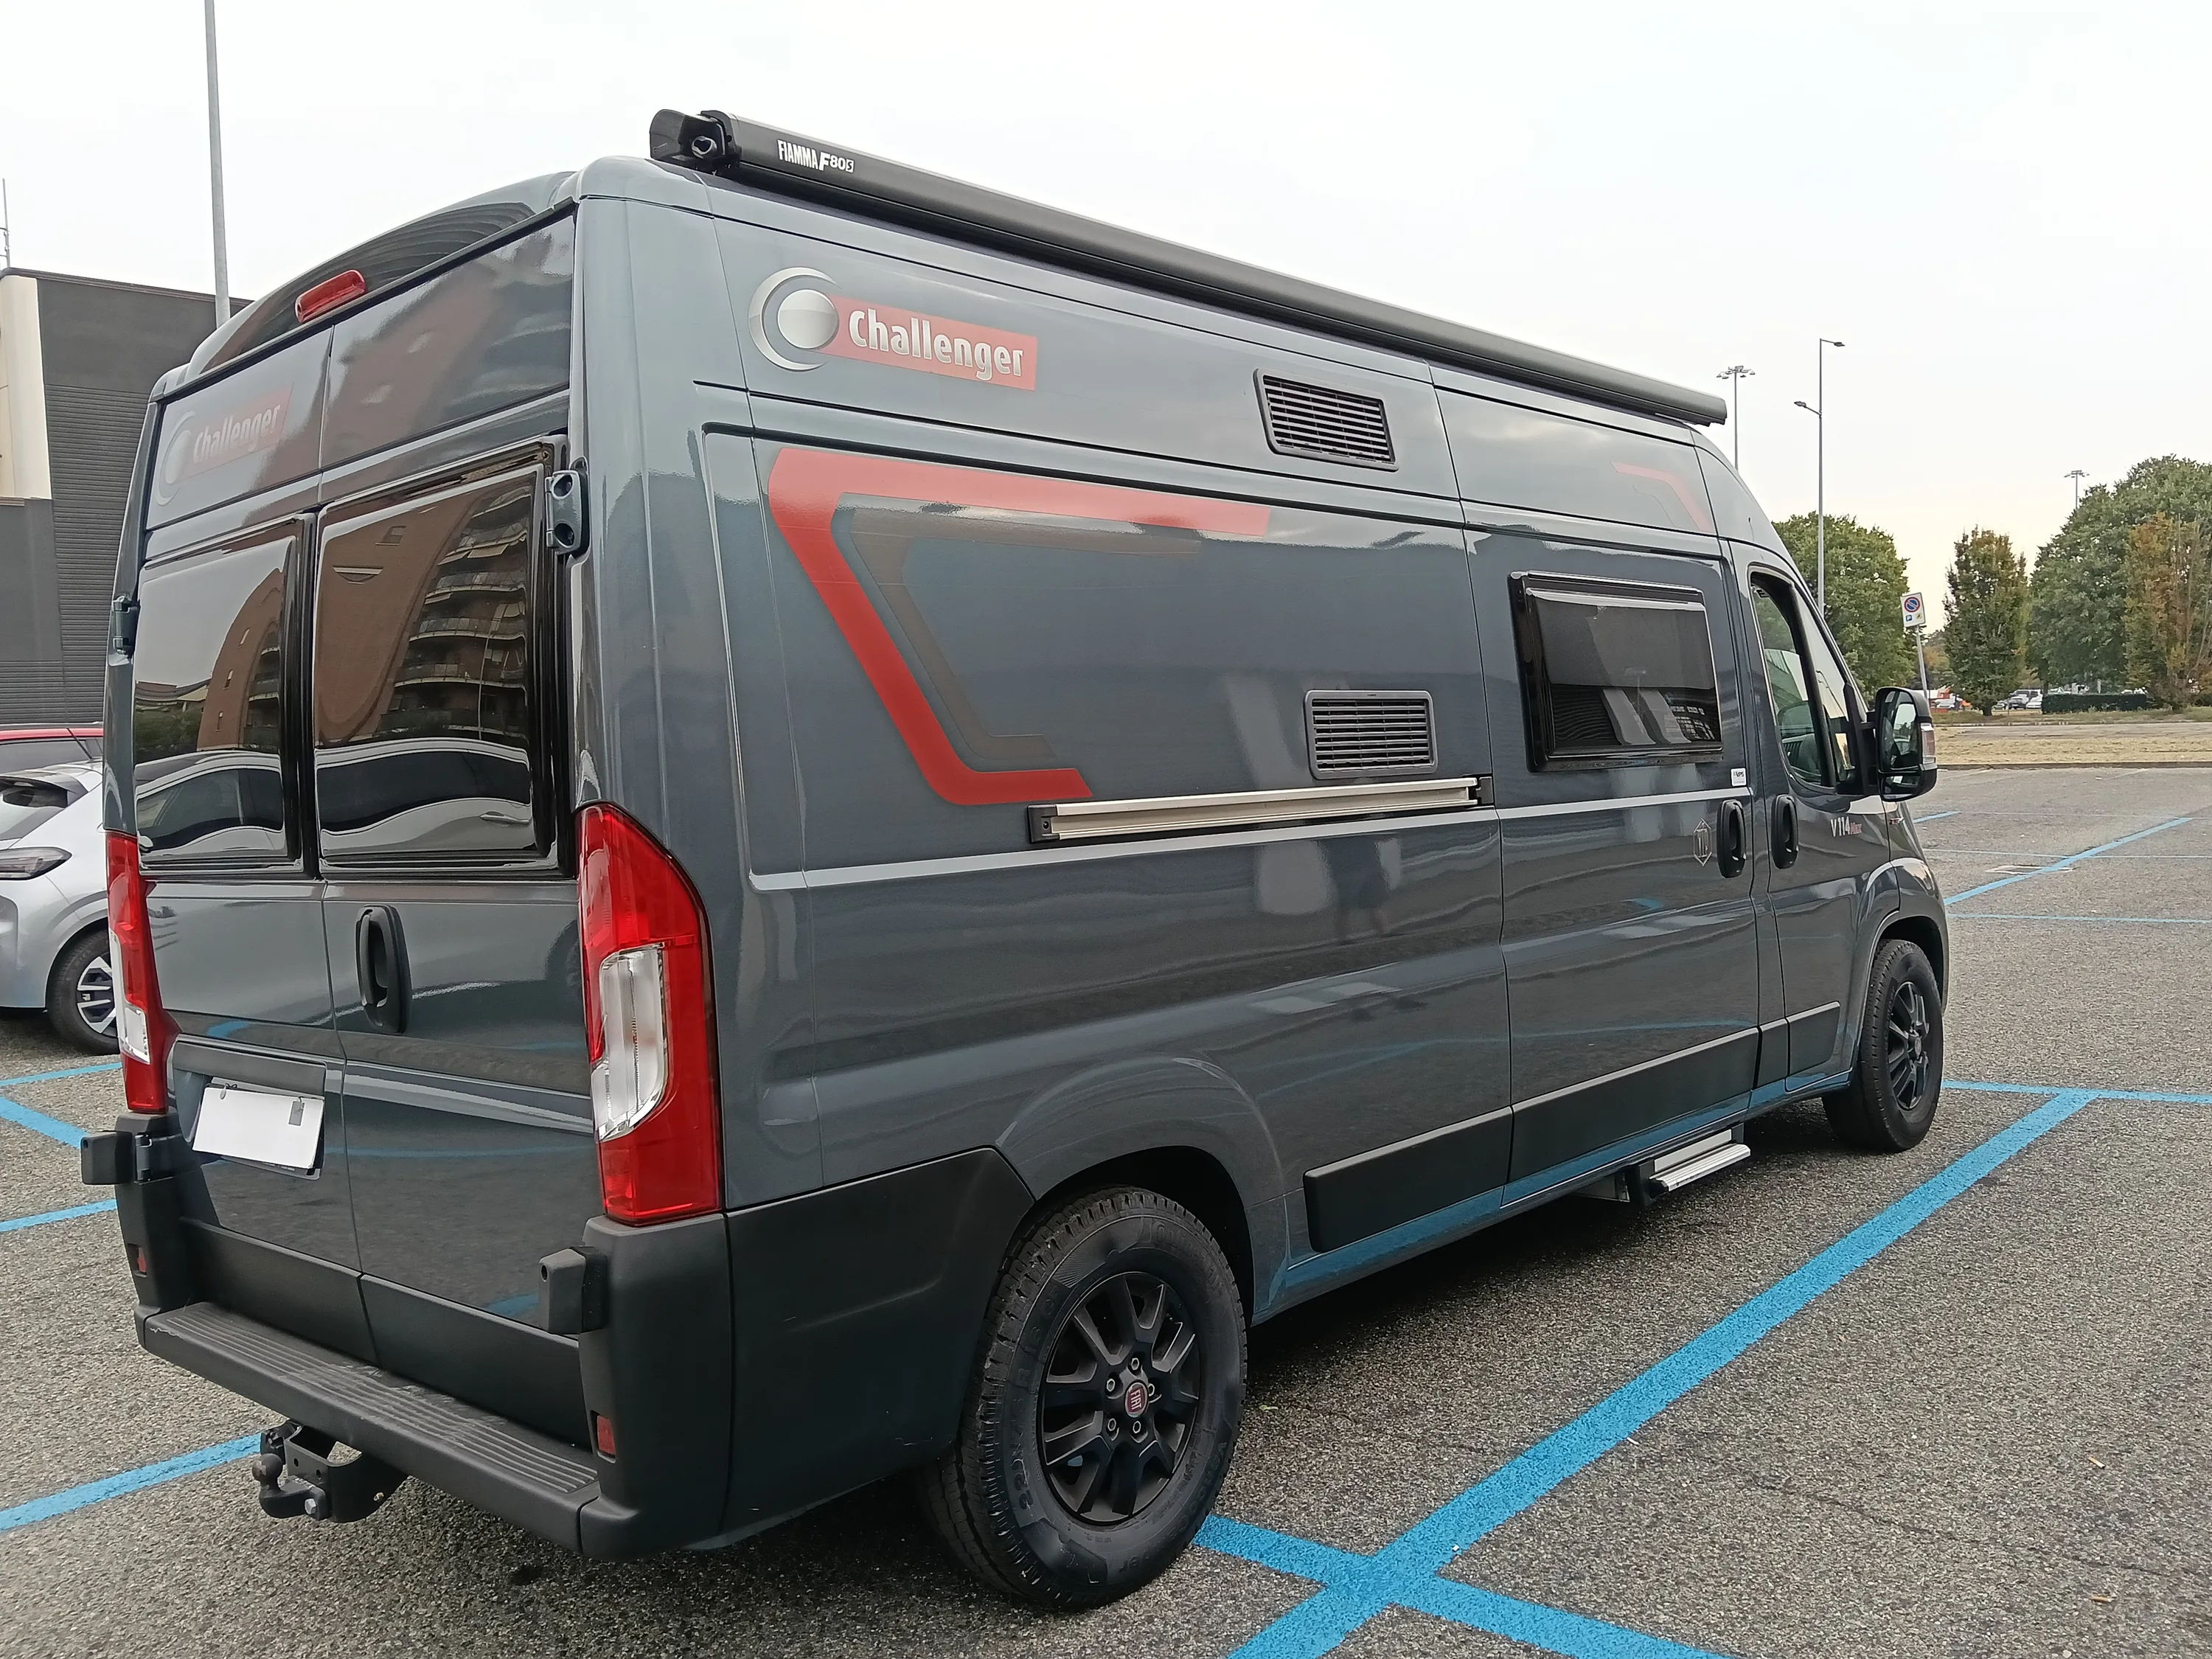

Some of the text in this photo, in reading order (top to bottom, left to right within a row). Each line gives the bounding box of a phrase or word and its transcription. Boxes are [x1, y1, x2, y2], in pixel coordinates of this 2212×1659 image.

[776, 139, 819, 170] FIAMMA
[848, 307, 1024, 381] Challenger
[192, 403, 281, 465] Challenger
[1830, 815, 1851, 838] V114
[1130, 1388, 1143, 1411] FIAT
